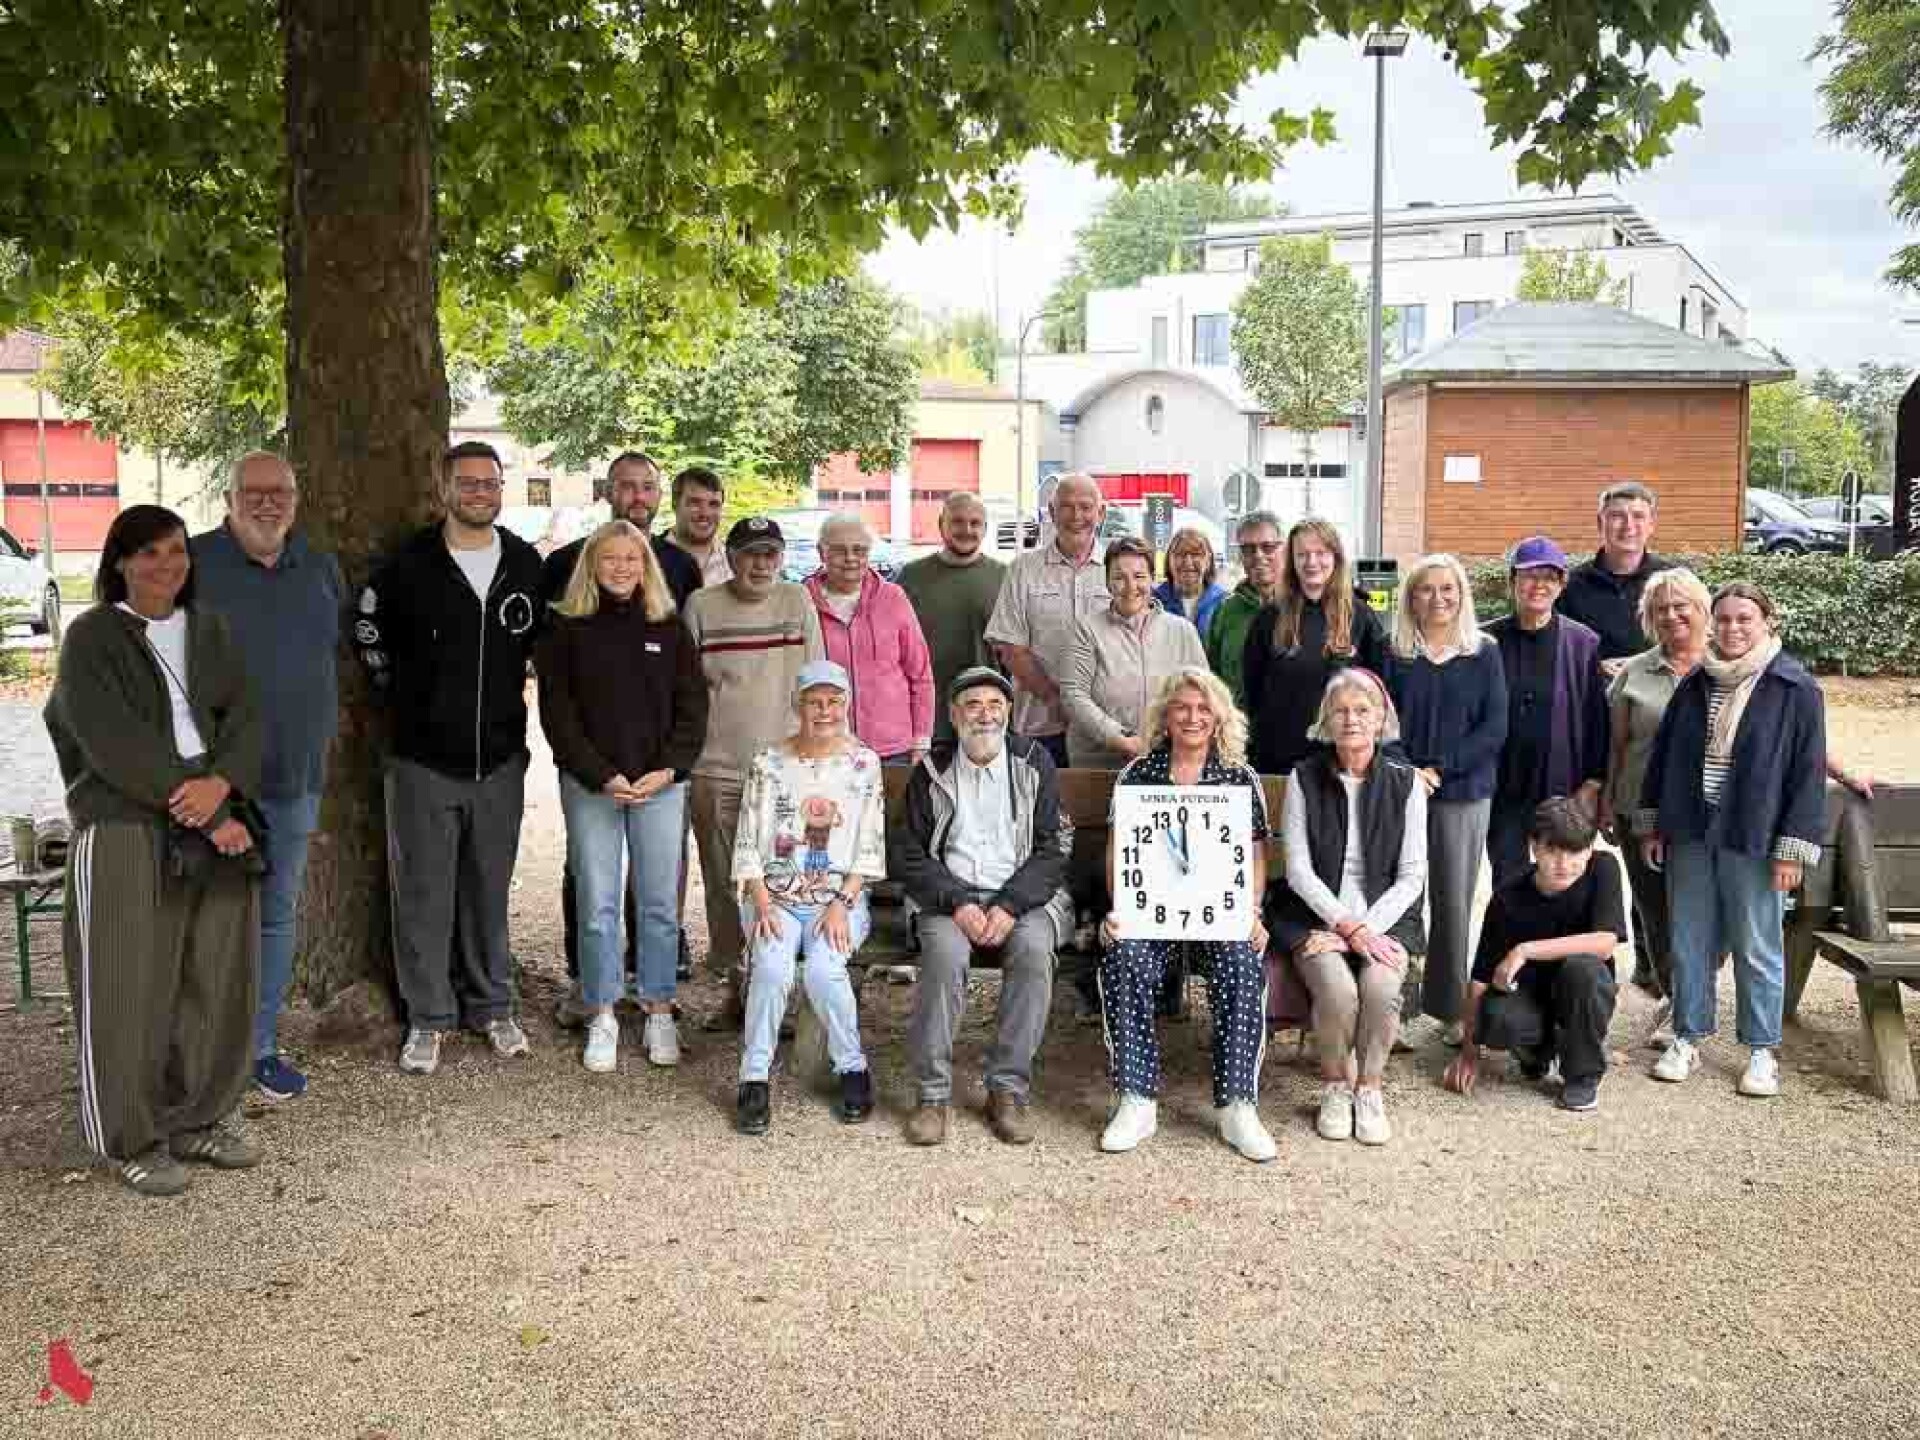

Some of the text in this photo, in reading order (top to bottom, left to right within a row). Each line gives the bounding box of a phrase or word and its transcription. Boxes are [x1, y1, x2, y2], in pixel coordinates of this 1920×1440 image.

[1152, 812, 1171, 830] 13
[1177, 806, 1188, 824] 0
[1202, 812, 1210, 830] 1
[1132, 826, 1152, 843] 12
[1219, 826, 1230, 843] 2
[1122, 846, 1139, 864] 11
[1234, 845, 1244, 864] 3
[1121, 869, 1143, 887] 10
[1234, 869, 1244, 888] 4
[1136, 891, 1146, 909] 9
[1224, 891, 1235, 910] 5
[1155, 905, 1166, 924] 8
[1179, 910, 1190, 929] 7
[1203, 905, 1214, 924] 6
